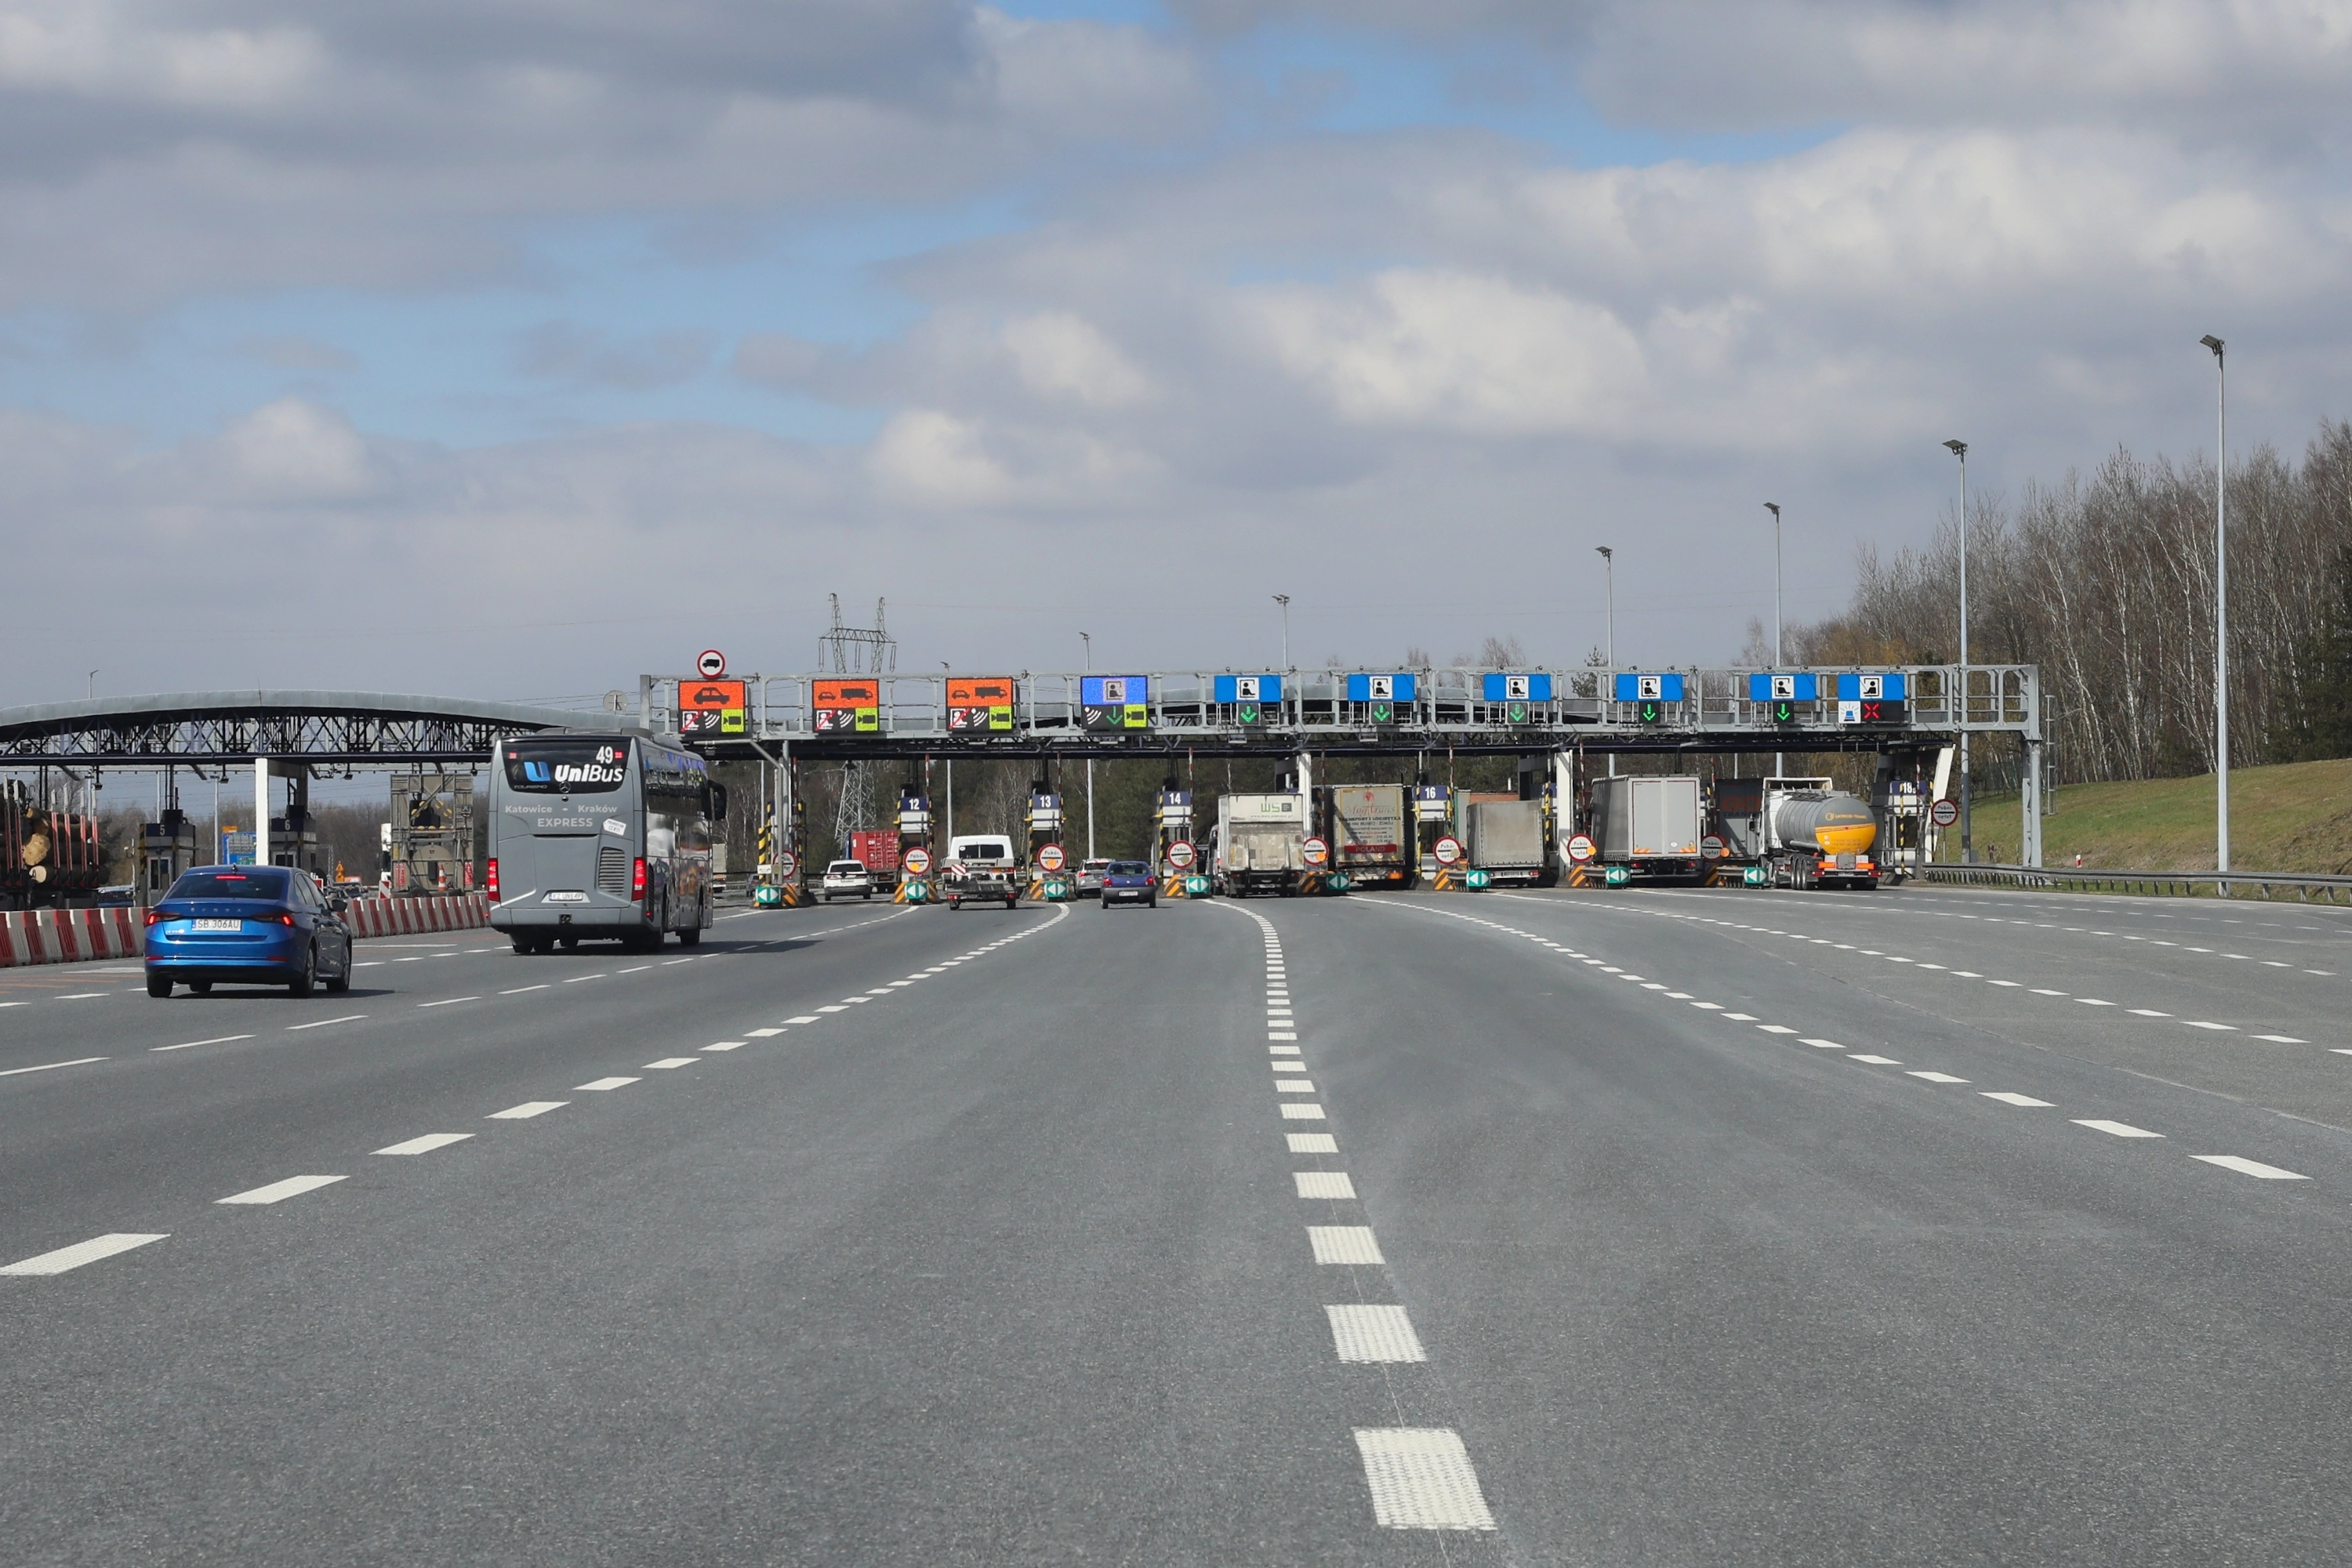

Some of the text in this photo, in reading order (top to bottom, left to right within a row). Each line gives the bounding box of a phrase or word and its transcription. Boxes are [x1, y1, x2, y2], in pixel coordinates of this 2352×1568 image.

[595, 746, 614, 764] 49
[554, 764, 624, 782] UniBus
[1169, 793, 1181, 804] 14
[1425, 786, 1436, 799] 16
[909, 798, 920, 810] 12
[1040, 795, 1051, 808] 13
[505, 804, 618, 813] Katowice Kraków
[284, 819, 290, 831] 6
[537, 818, 593, 828] EXPRESS
[159, 825, 165, 837] 5
[198, 919, 240, 928] SB 306AU
